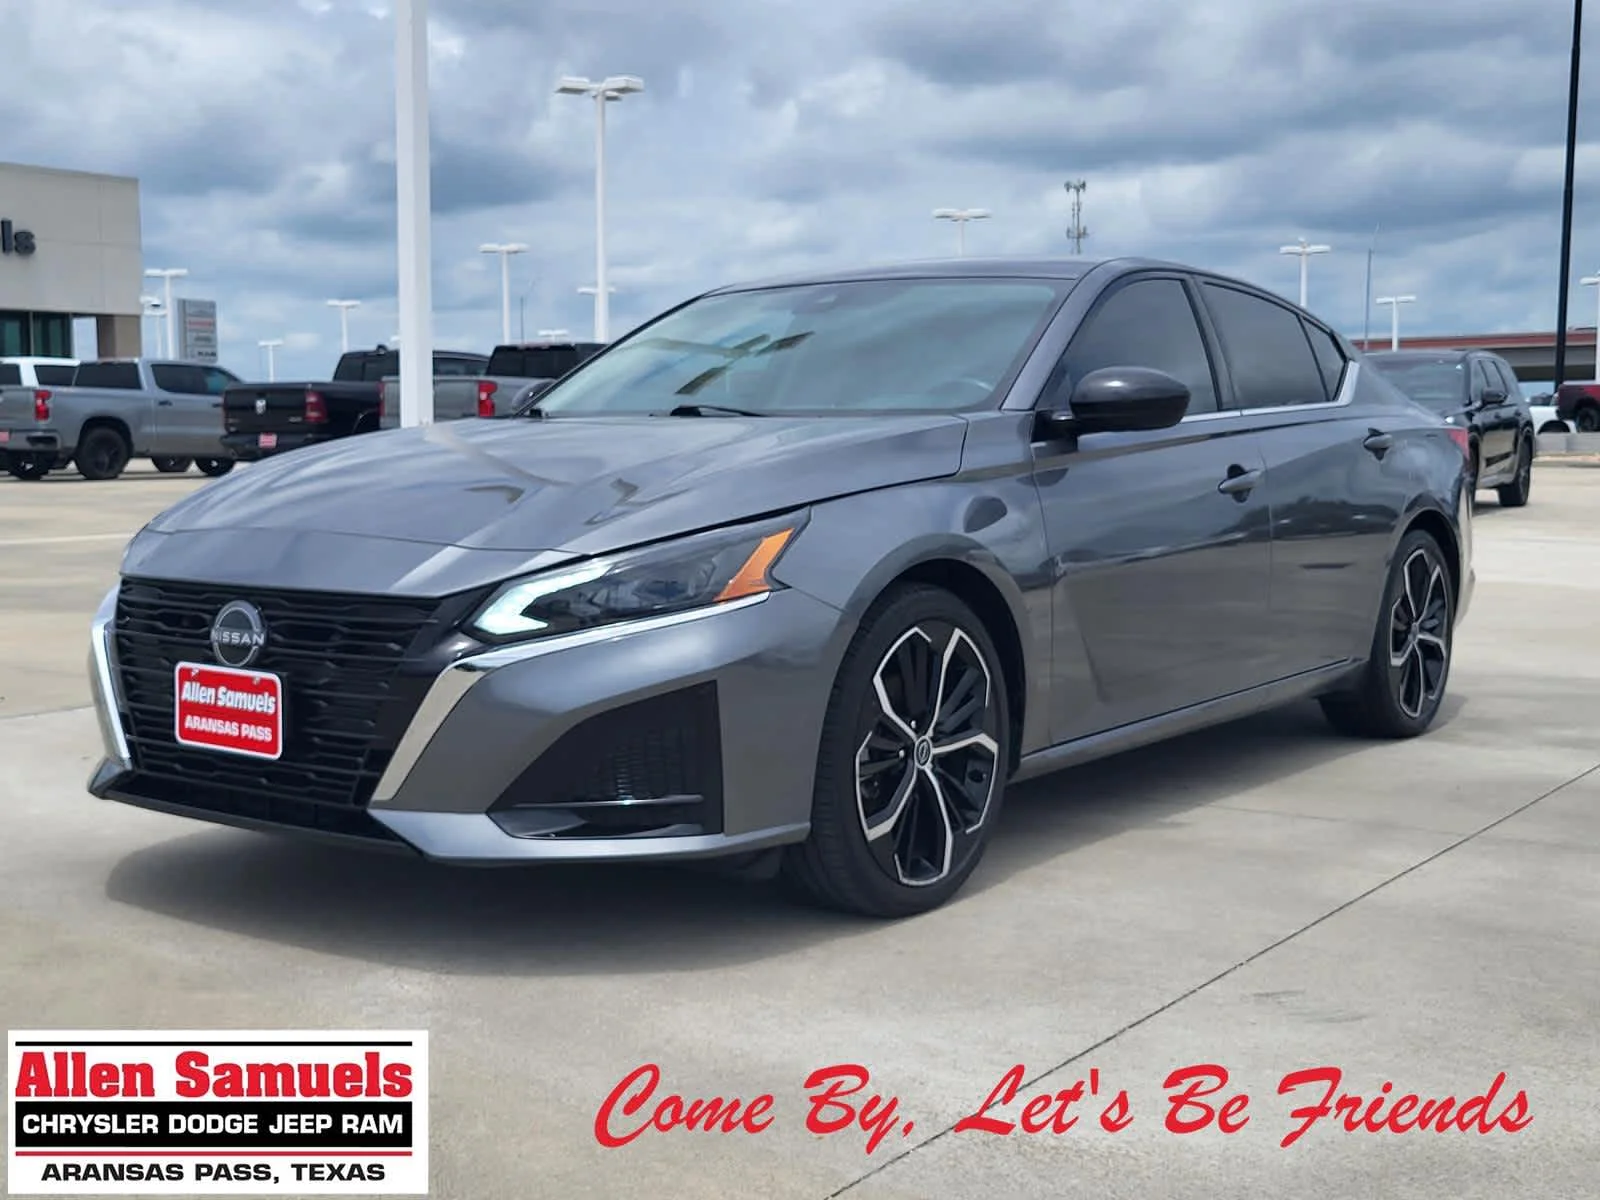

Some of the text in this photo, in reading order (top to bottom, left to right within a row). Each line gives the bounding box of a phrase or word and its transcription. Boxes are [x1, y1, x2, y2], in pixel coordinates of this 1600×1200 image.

[211, 629, 265, 646] NISSAN
[182, 681, 276, 715] Allen Samuels
[184, 714, 273, 743] ARANSAS PASS
